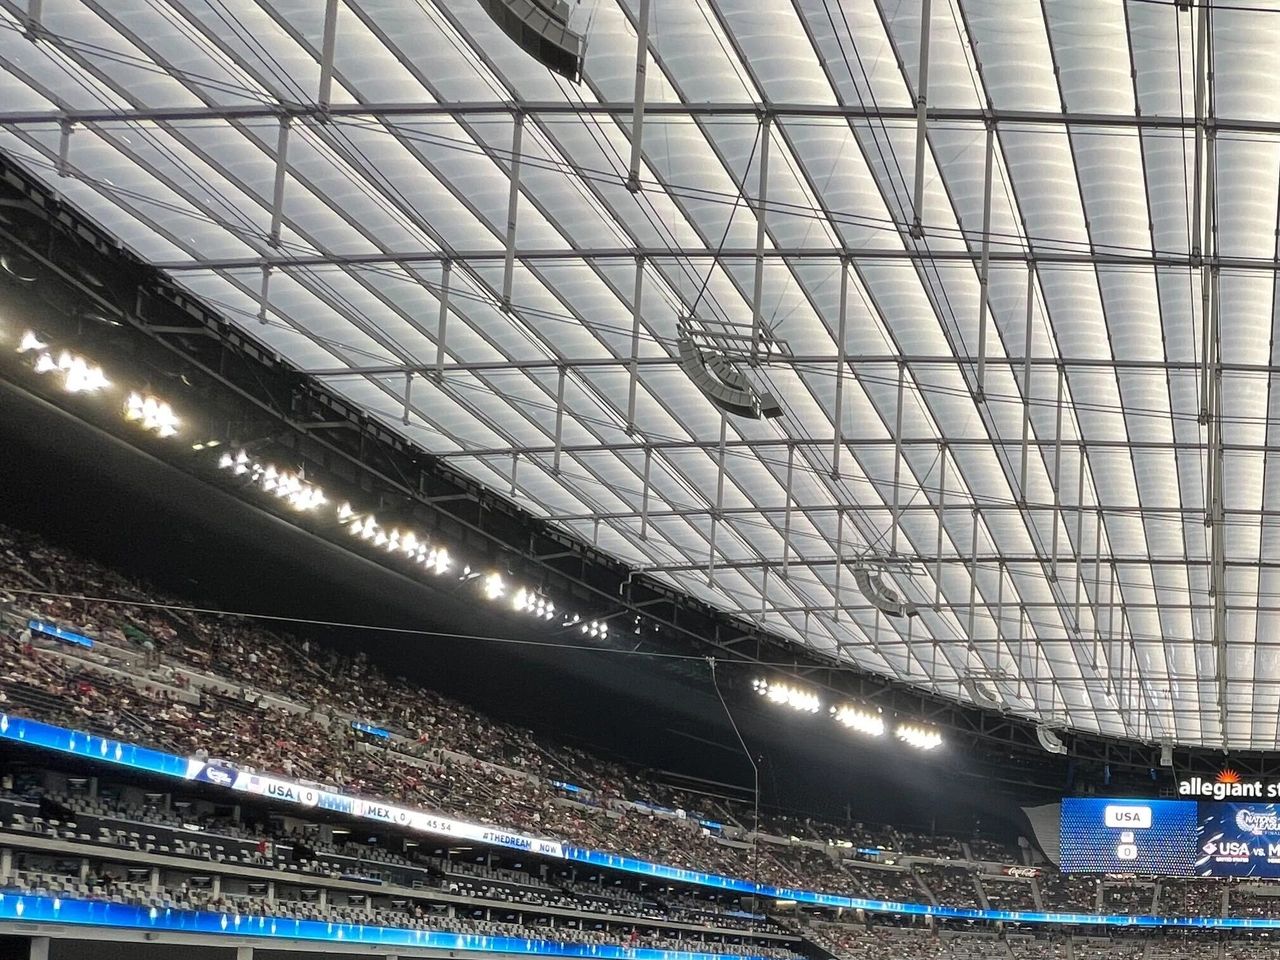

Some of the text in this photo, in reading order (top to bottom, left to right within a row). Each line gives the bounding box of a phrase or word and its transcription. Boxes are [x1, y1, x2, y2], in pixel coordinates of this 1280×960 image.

[267, 783, 313, 801] USA 0
[1179, 777, 1263, 801] allegiant
[367, 805, 390, 819] MEX
[1115, 812, 1141, 822] USA
[482, 831, 557, 854] #THEDREAM NOW
[1219, 842, 1250, 856] USA
[1124, 847, 1131, 857] 0
